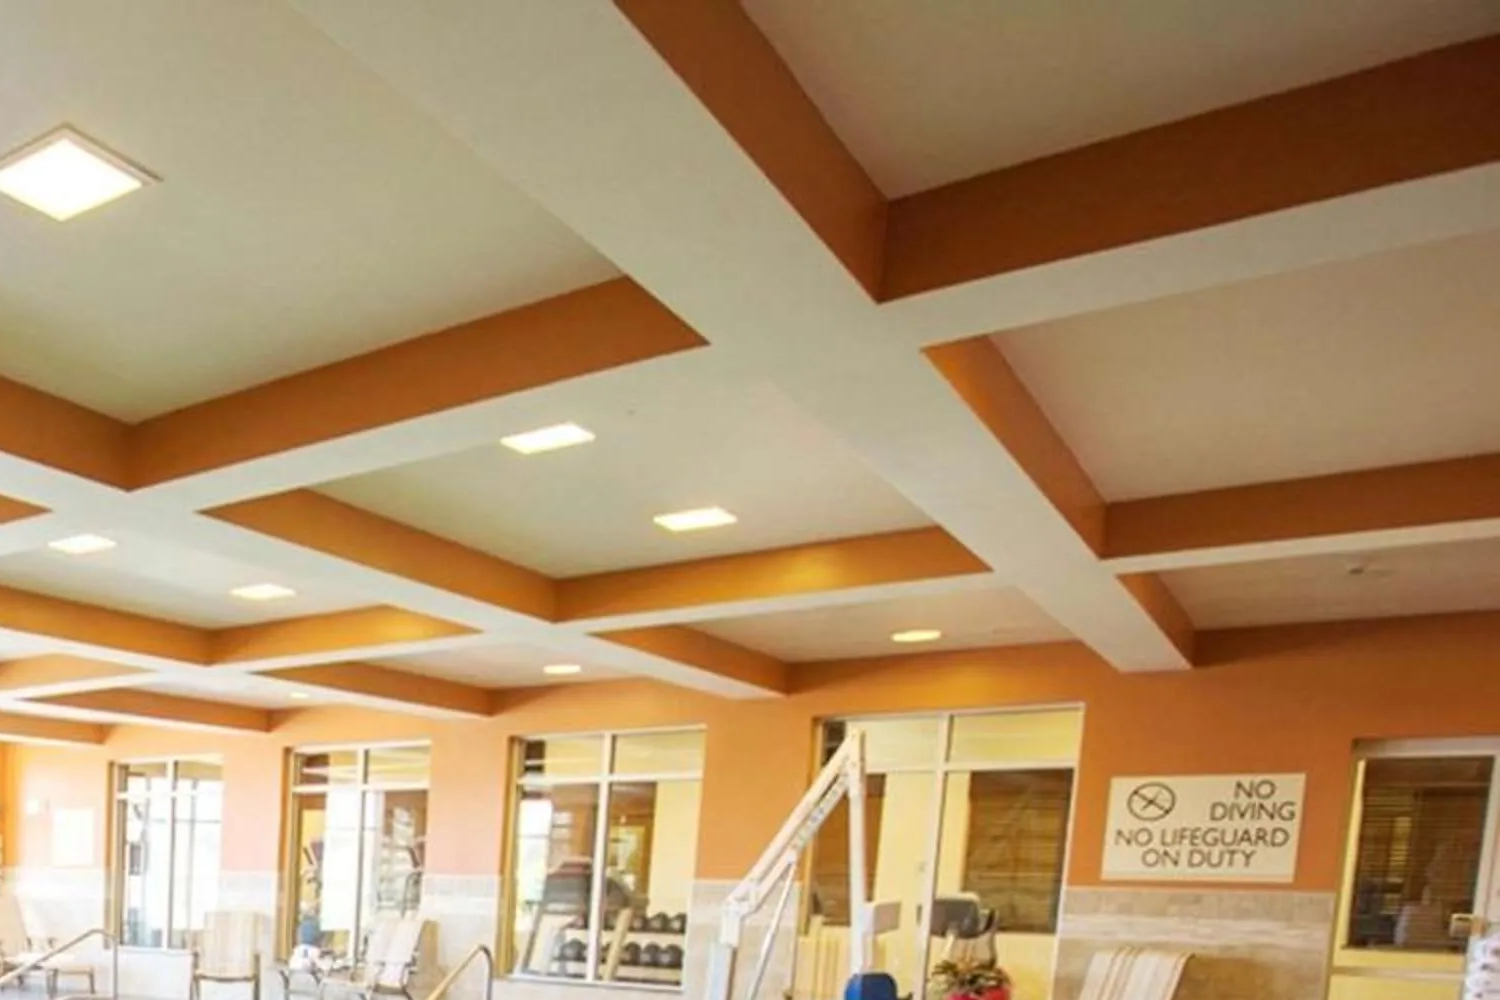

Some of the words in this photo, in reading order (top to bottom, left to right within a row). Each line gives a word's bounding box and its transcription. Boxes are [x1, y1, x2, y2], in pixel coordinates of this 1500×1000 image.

[1234, 780, 1277, 800] NO
[1210, 801, 1296, 821] DIVING
[1114, 827, 1153, 847] NO
[1160, 826, 1290, 847] LIFEGUARD
[1141, 849, 1180, 868] ON
[1187, 849, 1257, 868] DUTY
